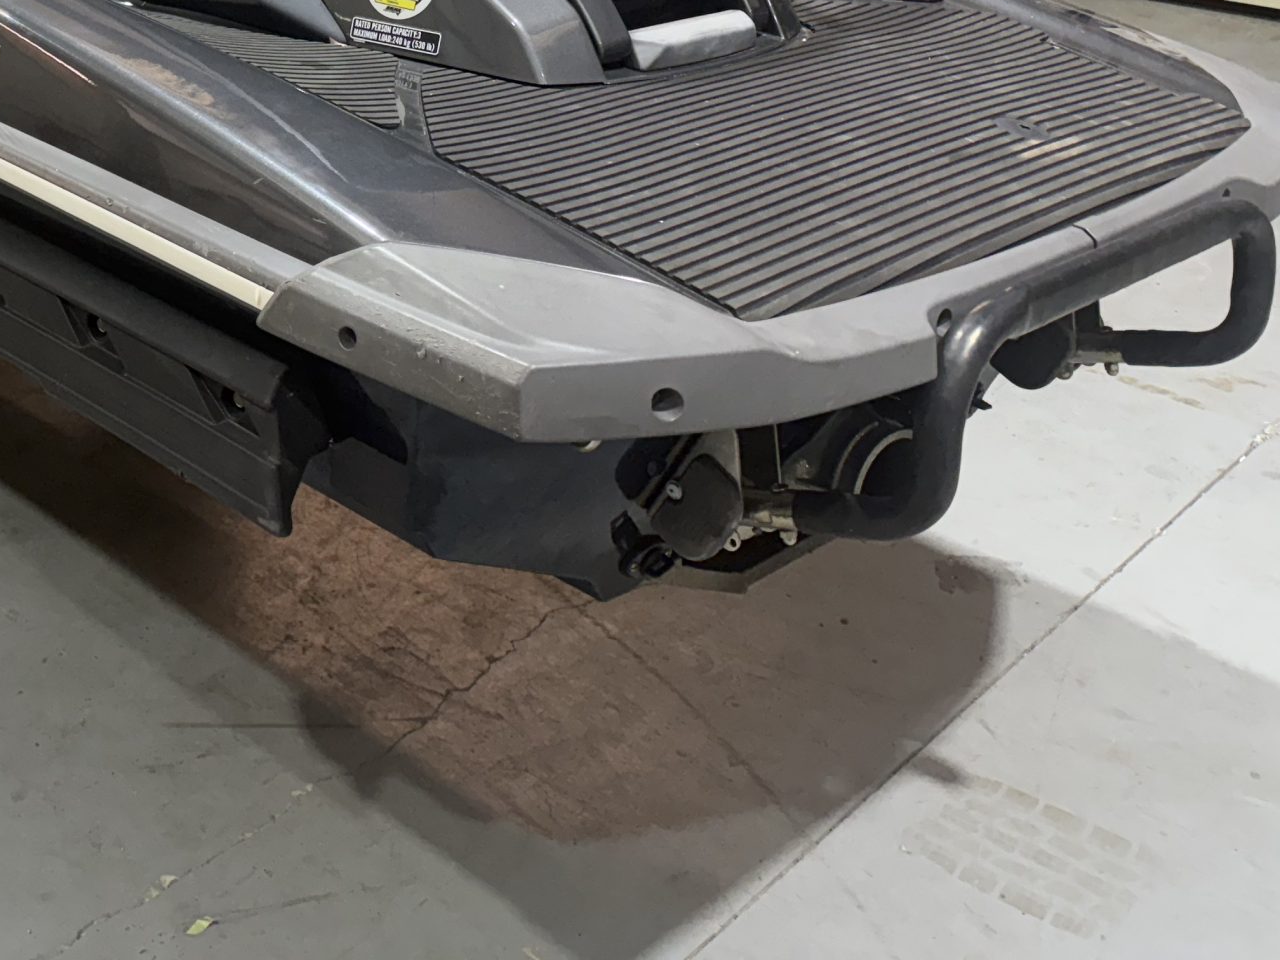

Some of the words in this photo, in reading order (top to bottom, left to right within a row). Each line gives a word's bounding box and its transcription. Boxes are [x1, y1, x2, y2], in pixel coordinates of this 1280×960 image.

[355, 19, 371, 30] RATED
[371, 22, 392, 34] PERSON
[353, 28, 378, 41] MAXIMUM
